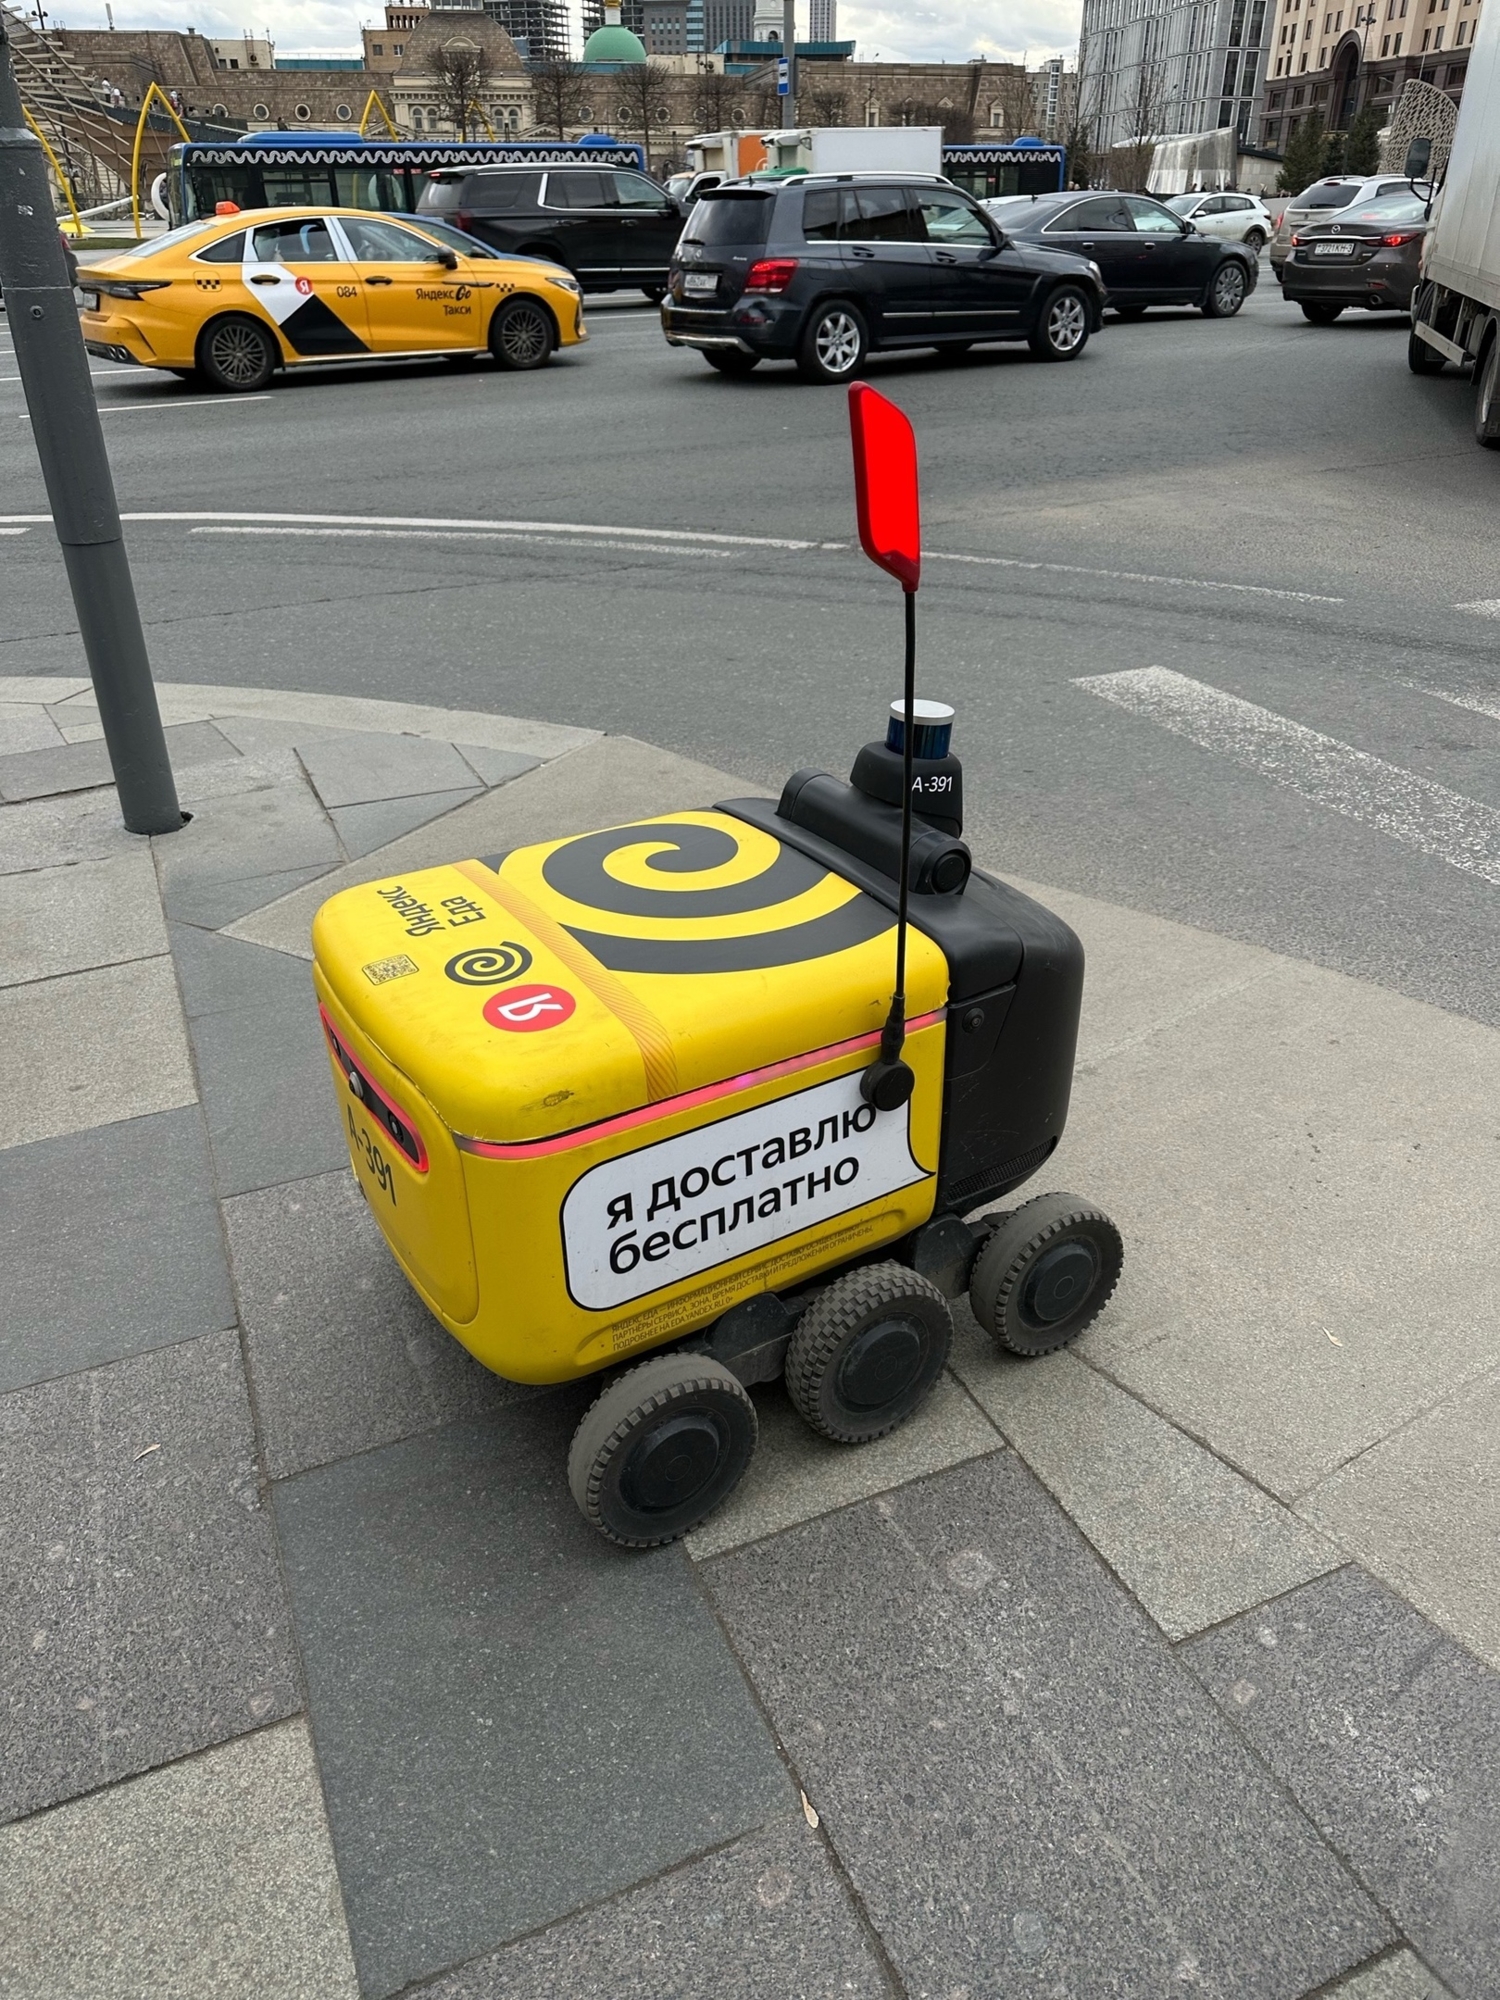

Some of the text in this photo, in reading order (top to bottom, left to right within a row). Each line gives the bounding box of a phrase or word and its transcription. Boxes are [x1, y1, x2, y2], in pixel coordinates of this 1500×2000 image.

[299, 281, 310, 293] Я
[336, 286, 358, 298] 084
[415, 284, 472, 301] Яндекс Go
[442, 304, 472, 316] Такси
[911, 776, 953, 793] A-391
[376, 885, 446, 937] Яндекс
[440, 895, 487, 928] Еда
[497, 992, 564, 1022] Я
[346, 1102, 397, 1207] A-391
[606, 1102, 877, 1231] я доставлю
[608, 1156, 860, 1275] бесплатно
[712, 1283, 735, 1301] ВРЕМЯ
[735, 1267, 772, 1291] ДОСТАВКИ
[779, 1242, 828, 1271] ПРЕДЛОЖЕНИЯ
[611, 1314, 641, 1334] ЯНДЕКС
[642, 1307, 658, 1321] ЕДА
[613, 1325, 658, 1352] ПОДРОБНЕЕ
[659, 1320, 670, 1332] НА
